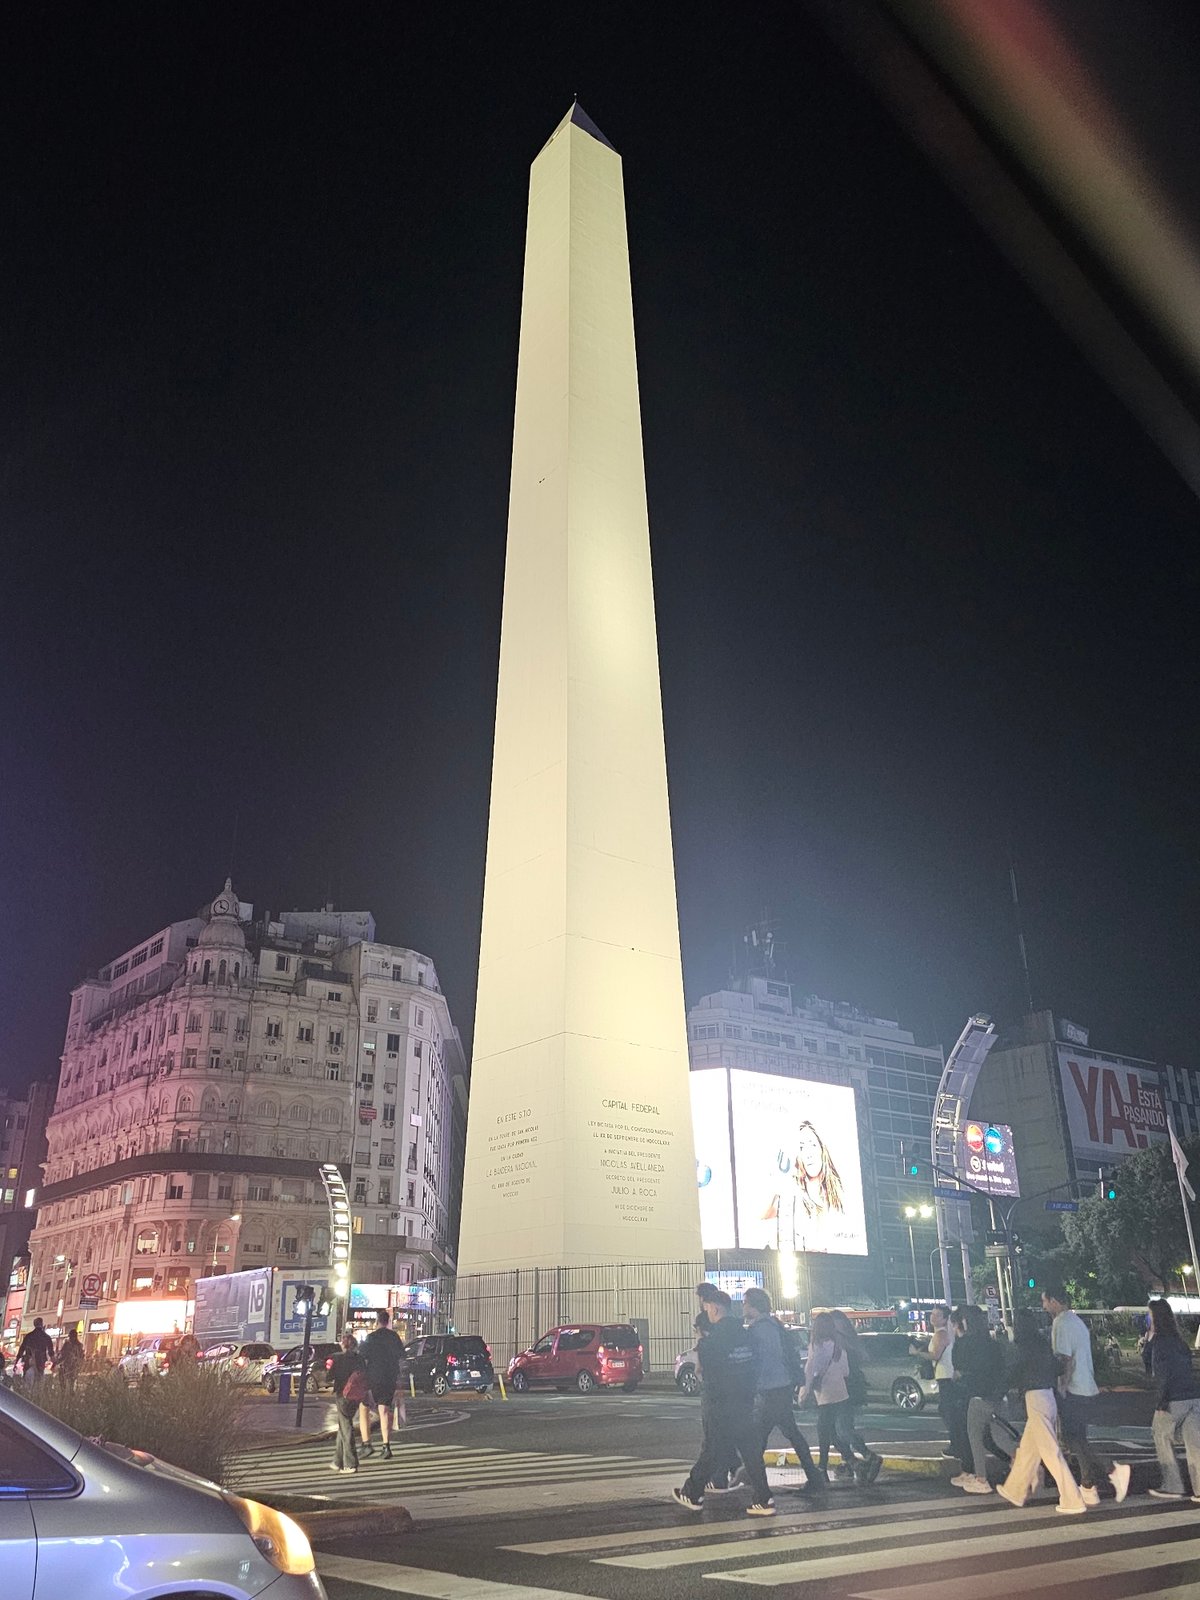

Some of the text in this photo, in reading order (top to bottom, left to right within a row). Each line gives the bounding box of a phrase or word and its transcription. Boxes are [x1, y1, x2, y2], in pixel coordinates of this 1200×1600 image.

[1138, 1089, 1162, 1108] ESTÁ
[601, 1099, 660, 1115] CAPITAL FEDERAL
[496, 1116, 504, 1125] EN
[504, 1112, 517, 1123] ESTE
[1123, 1105, 1165, 1127] PASANDO
[600, 1159, 628, 1169] NICOLAS
[611, 1186, 629, 1195] JULIO
[639, 1188, 657, 1197] ROCA
[250, 1283, 265, 1313] NB
